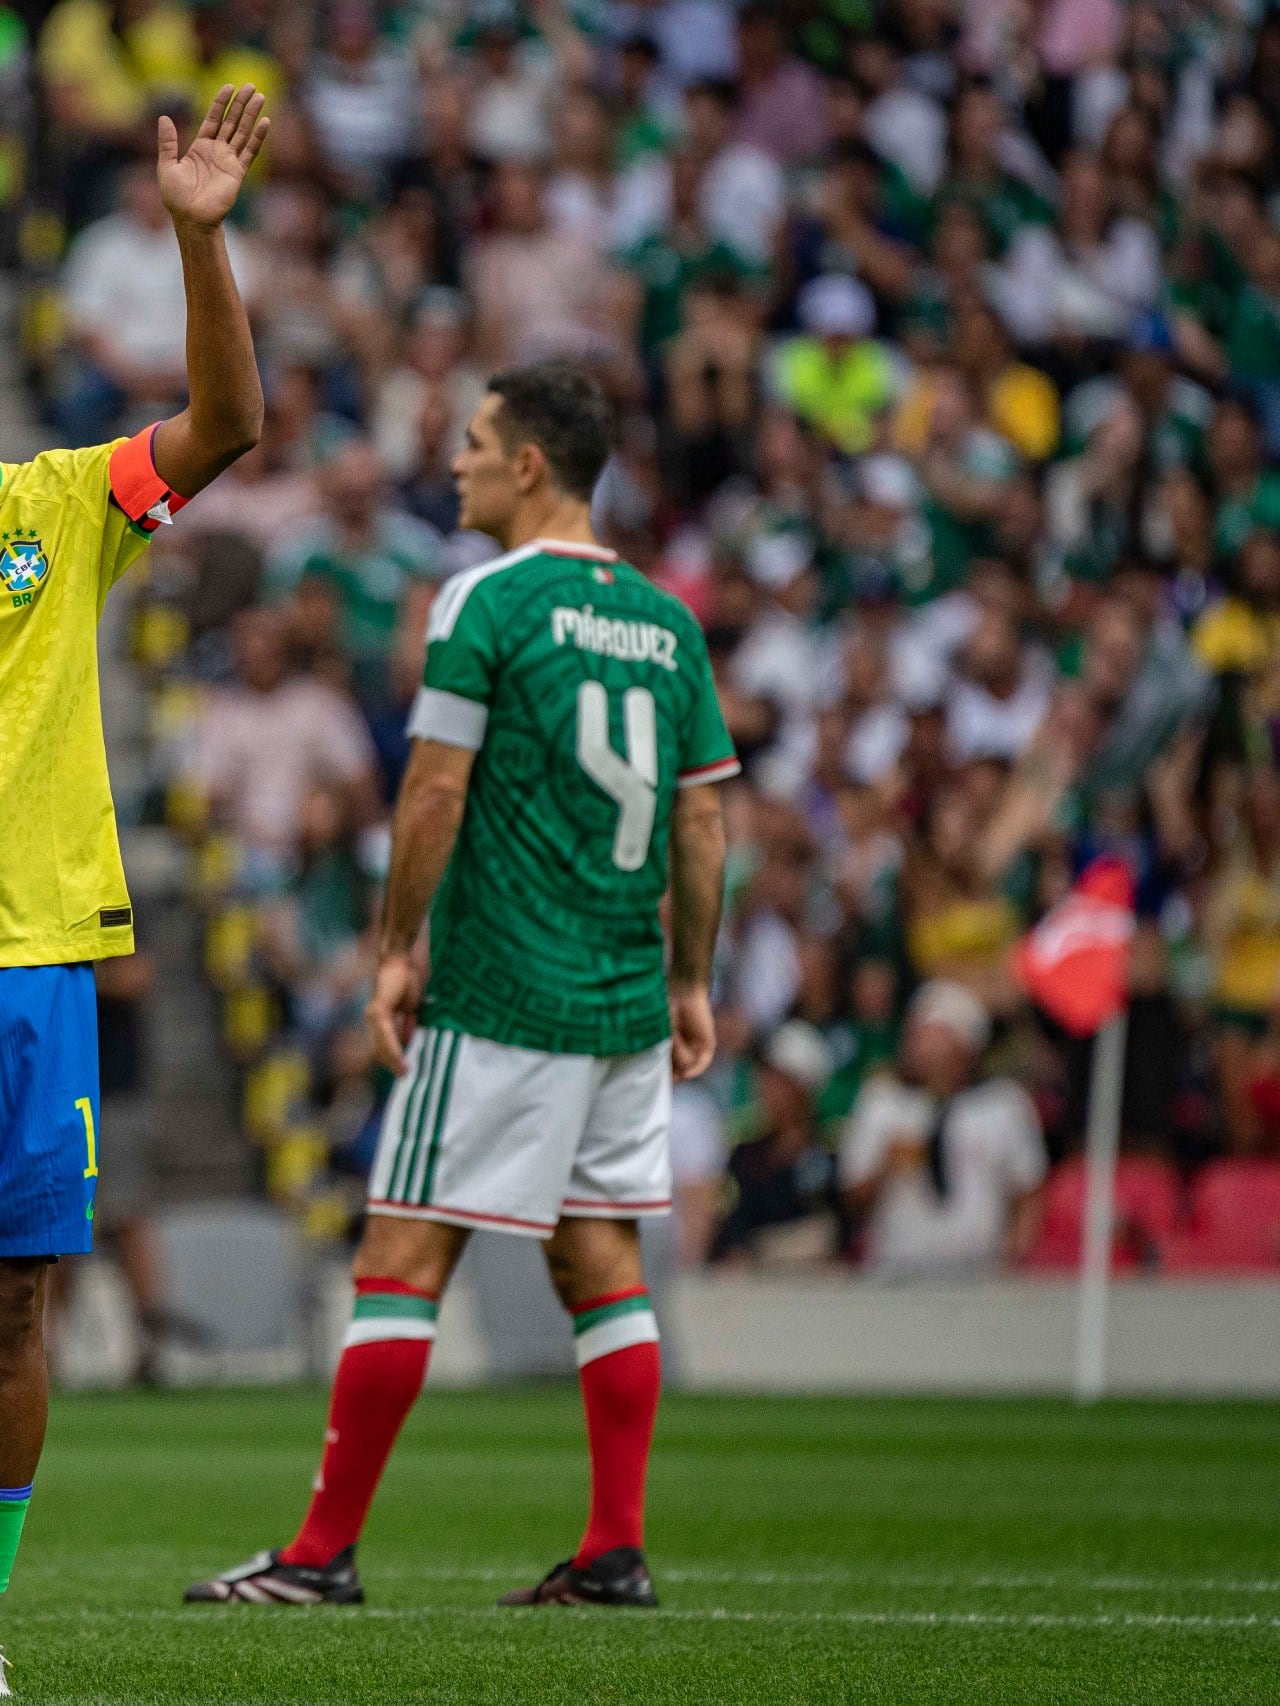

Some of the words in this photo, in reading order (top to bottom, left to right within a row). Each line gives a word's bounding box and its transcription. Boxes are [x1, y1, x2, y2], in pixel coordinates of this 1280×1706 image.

[15, 561, 32, 575] CBF
[552, 605, 678, 670] MÁRQUEZ
[578, 681, 658, 871] 4
[74, 1097, 98, 1178] 1
